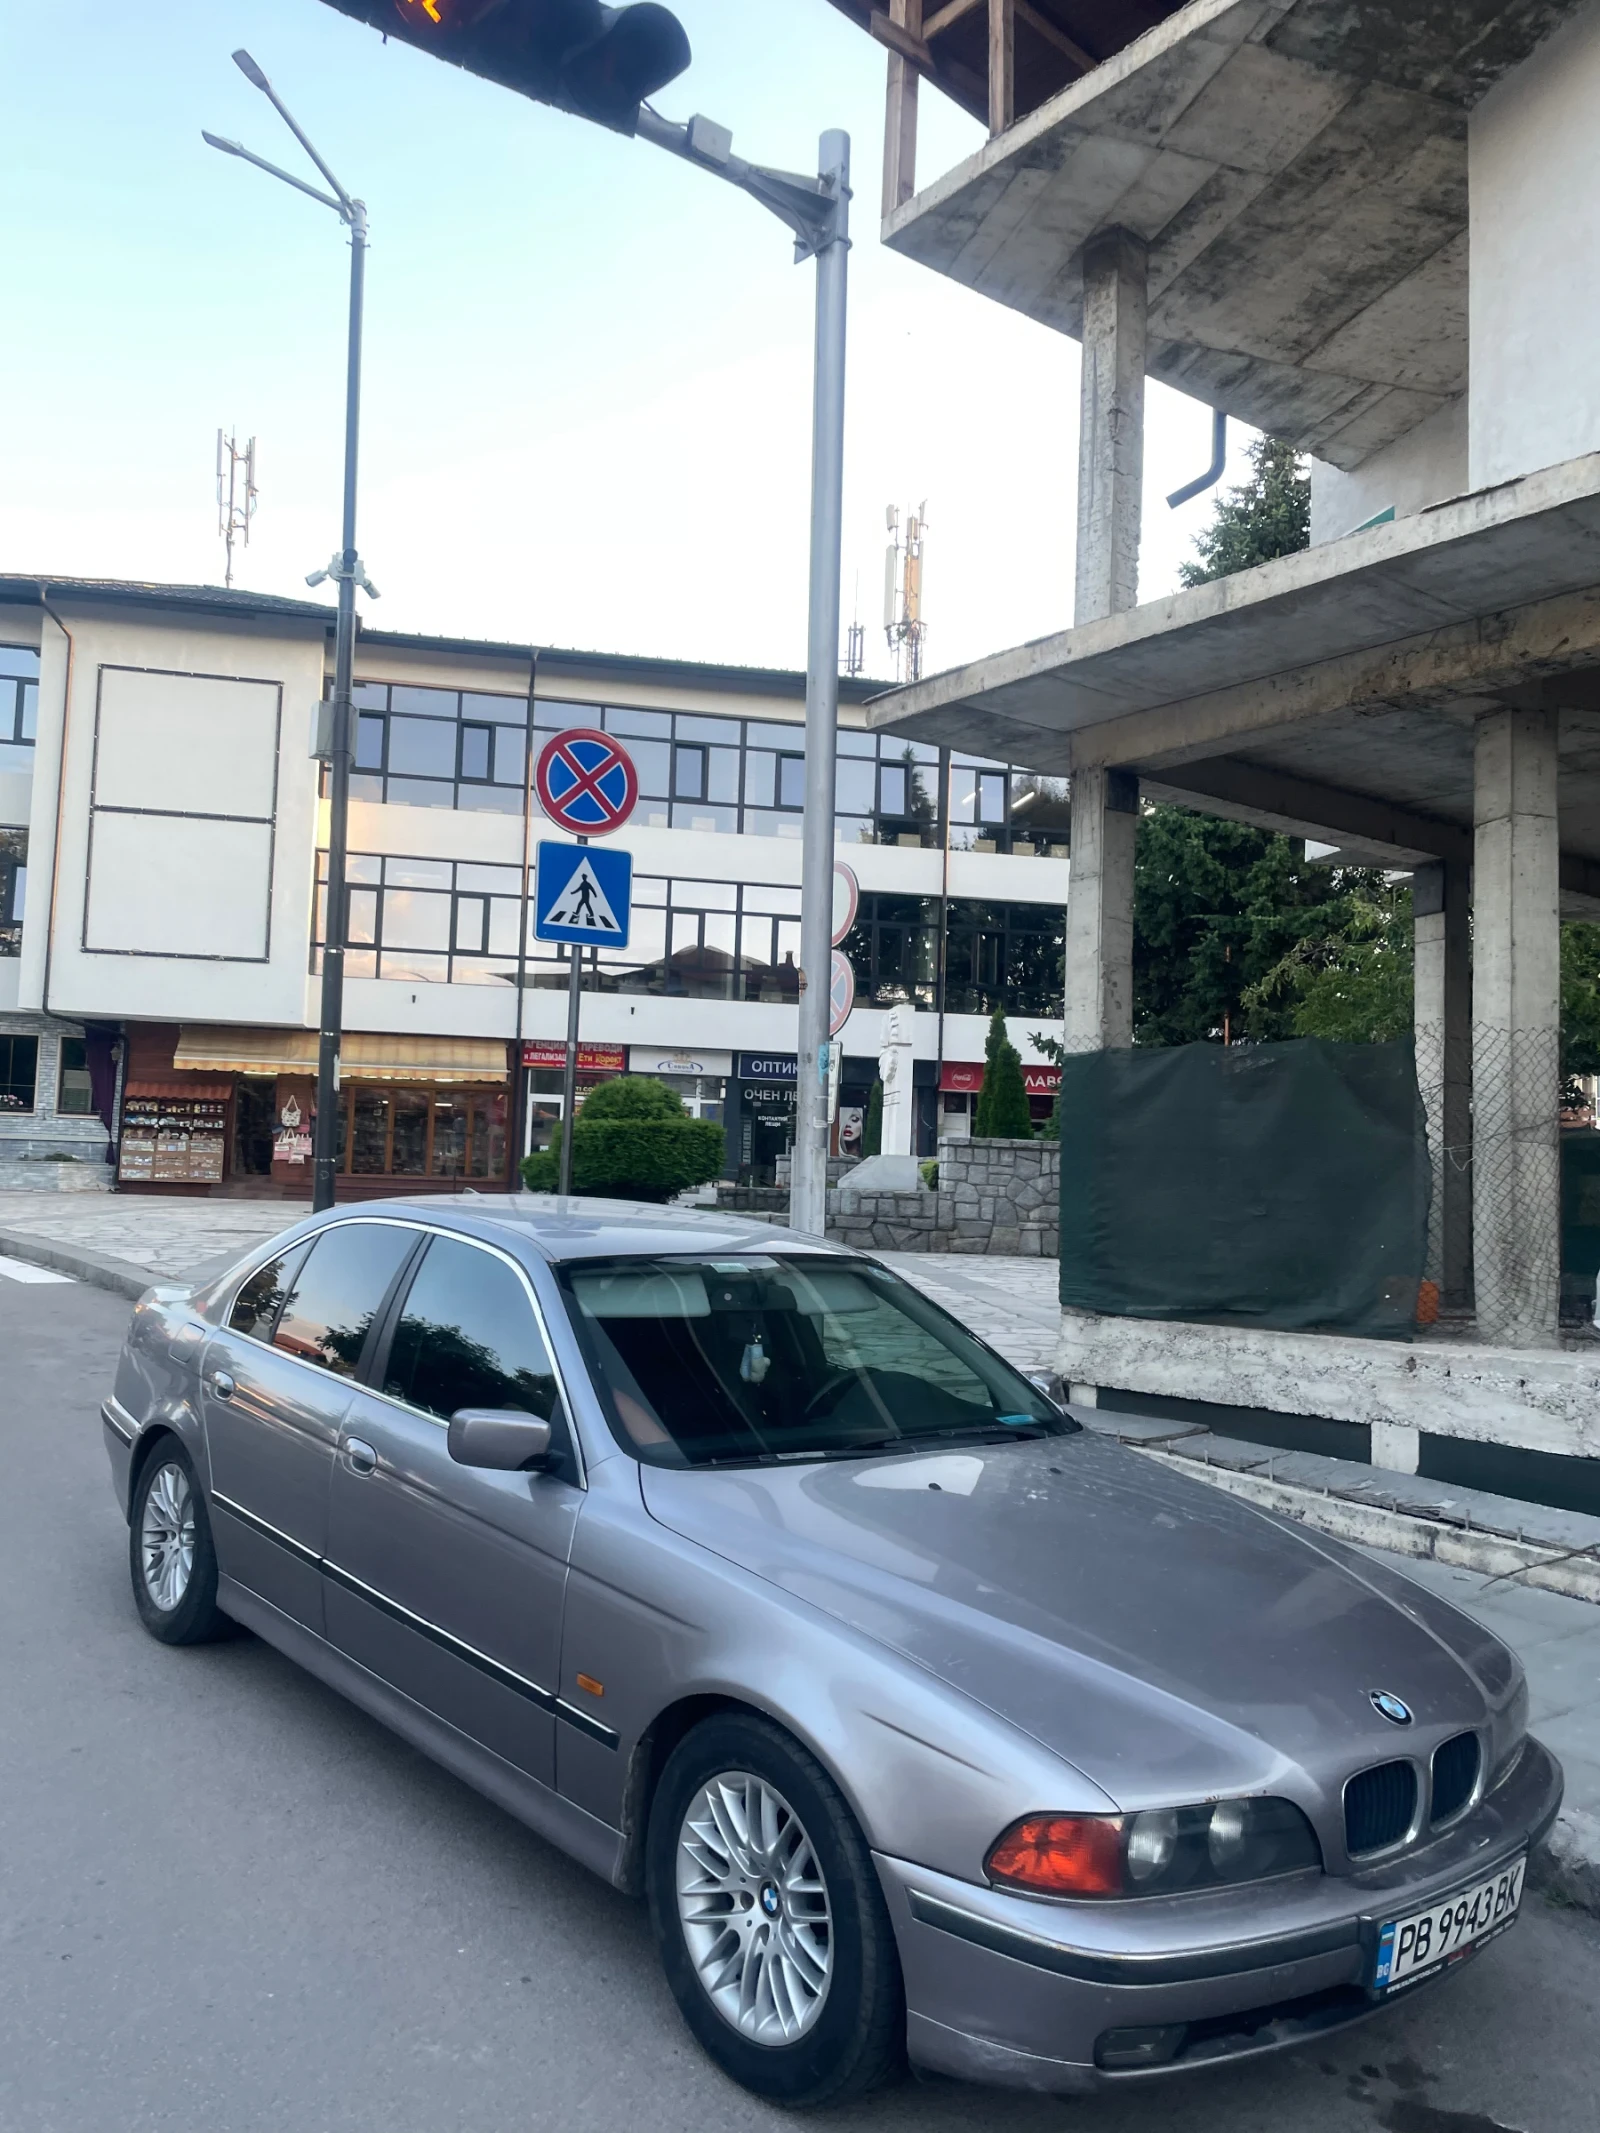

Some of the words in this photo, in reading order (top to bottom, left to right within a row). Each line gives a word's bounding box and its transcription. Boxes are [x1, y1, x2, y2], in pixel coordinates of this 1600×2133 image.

[524, 1040, 566, 1051] АГЕНЦИЯ
[581, 1043, 623, 1053] ПРЕВОДИ
[744, 1088, 781, 1100] ОЧЕН
[1395, 1916, 1432, 1973] PB
[1438, 1886, 1493, 1953] 9943
[1493, 1864, 1521, 1920] BK
[1376, 1962, 1390, 1980] BG
